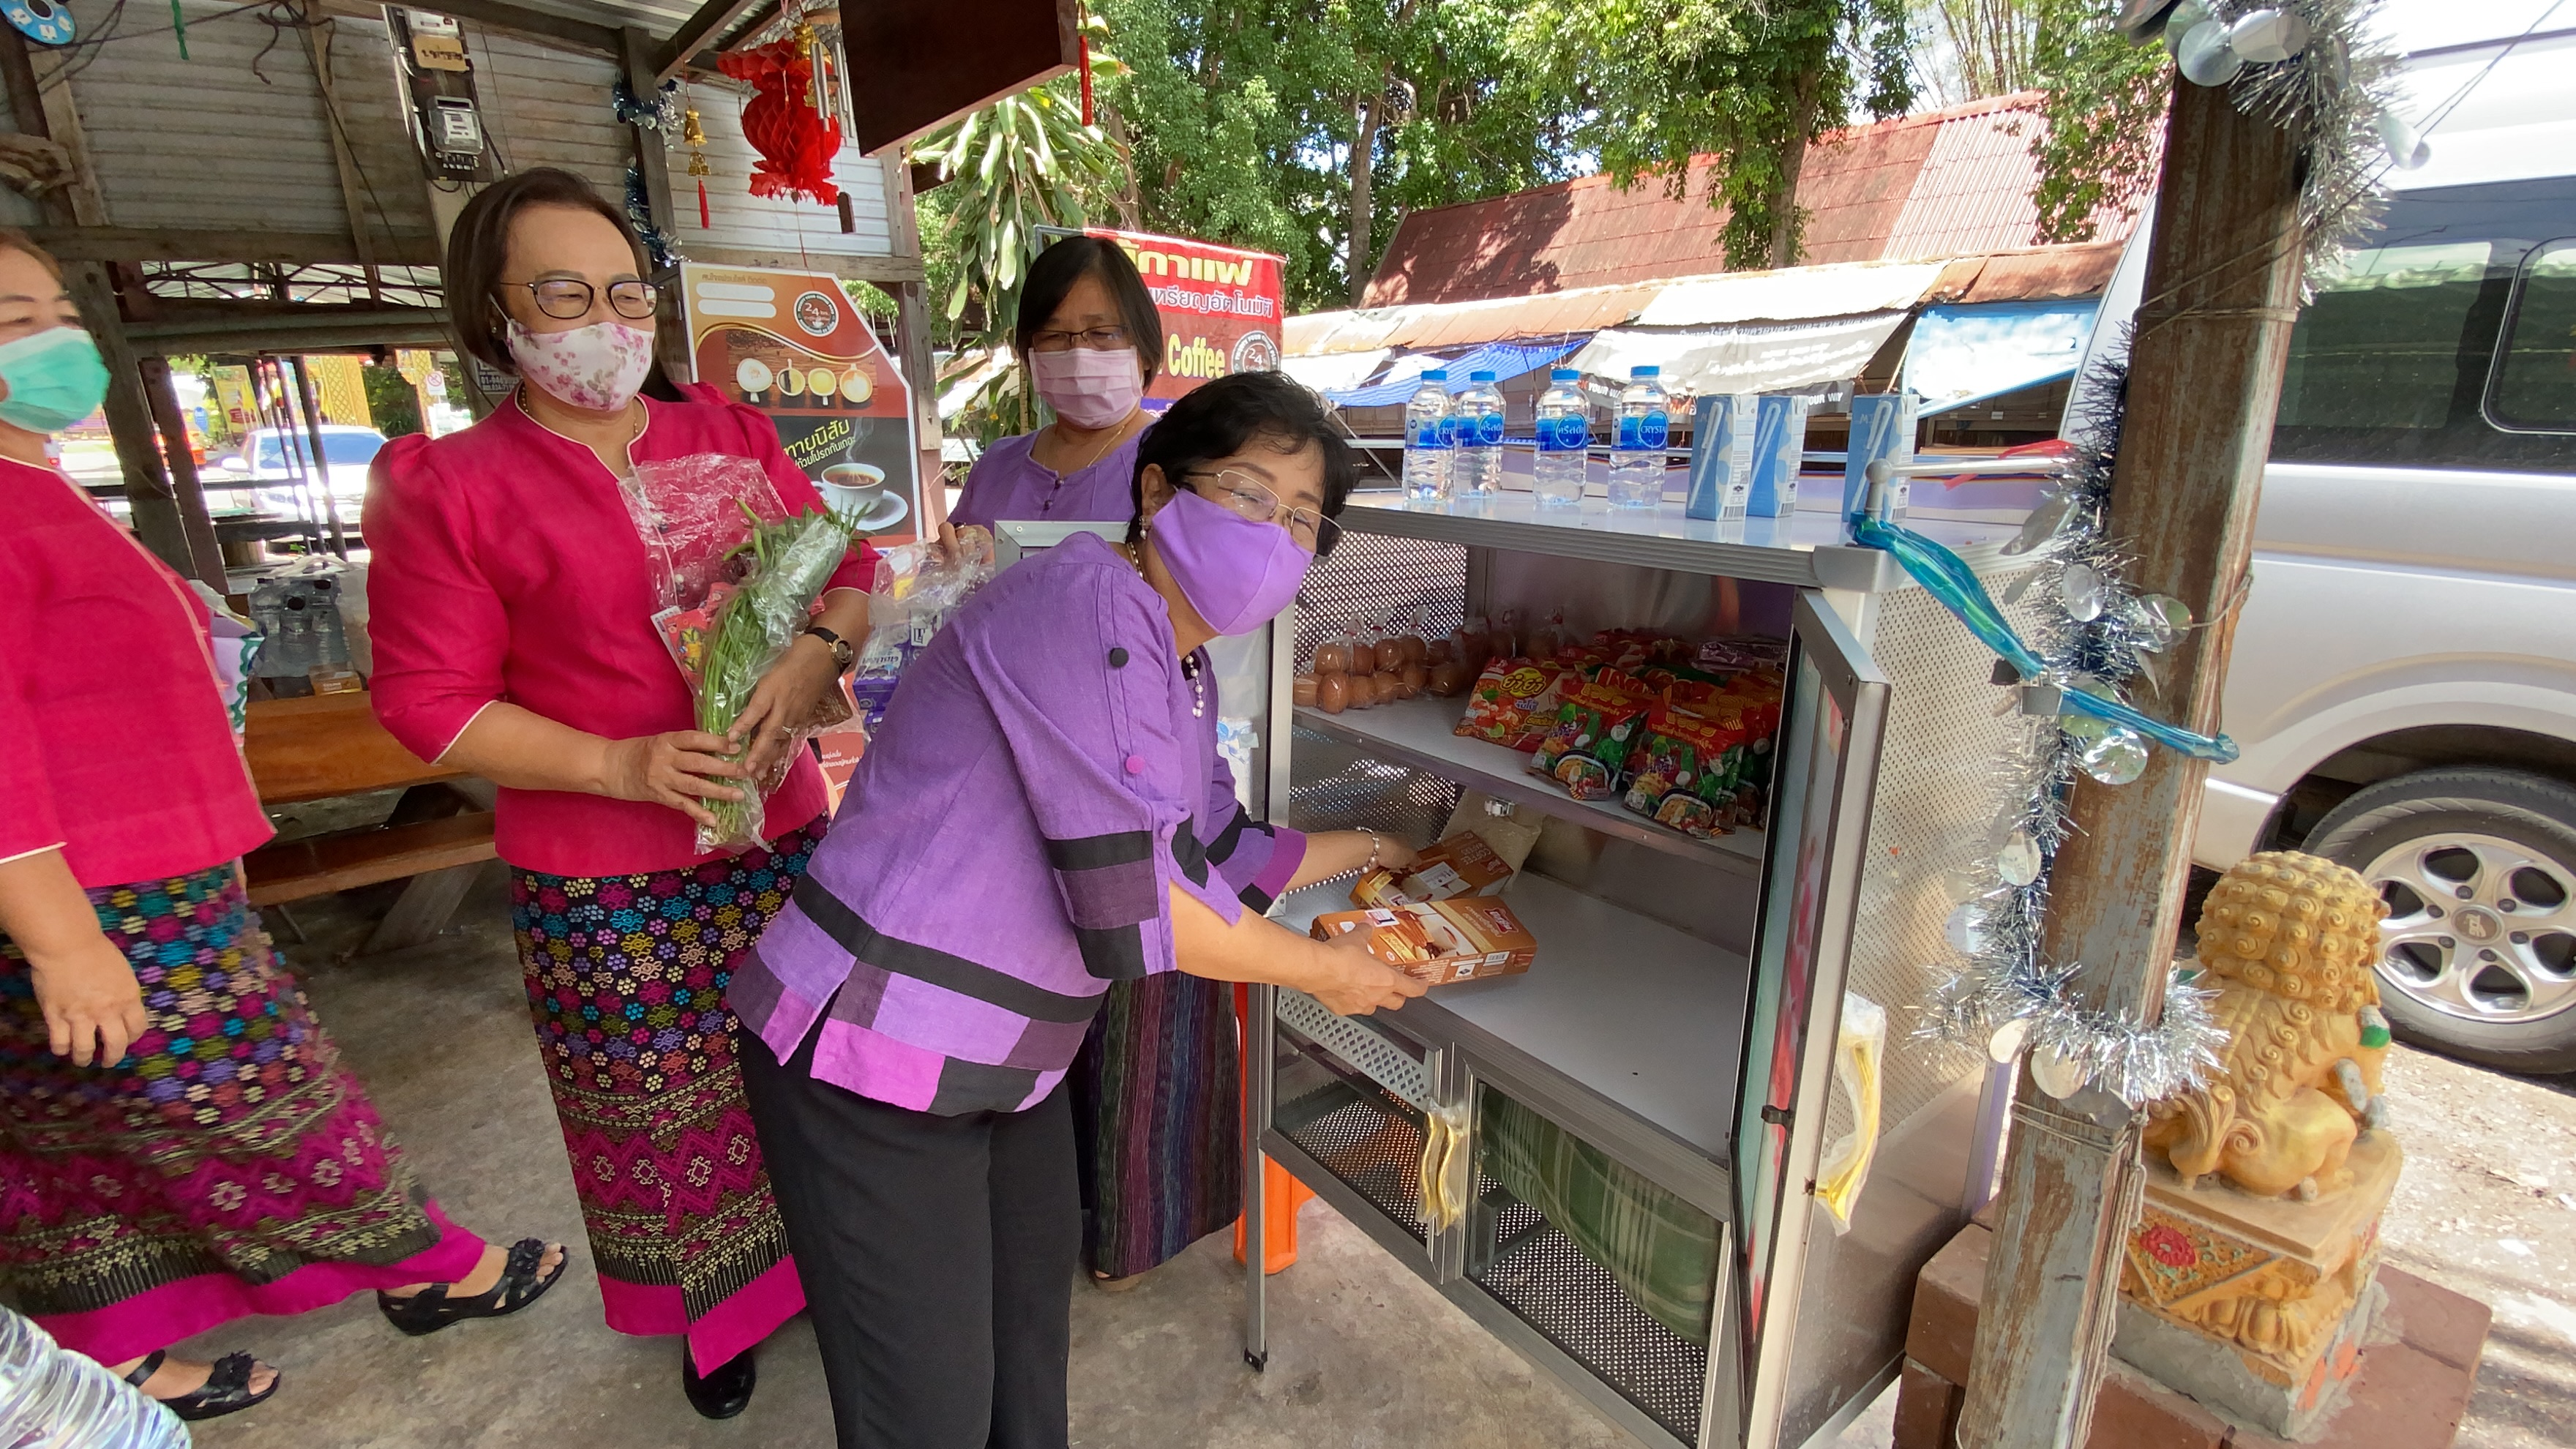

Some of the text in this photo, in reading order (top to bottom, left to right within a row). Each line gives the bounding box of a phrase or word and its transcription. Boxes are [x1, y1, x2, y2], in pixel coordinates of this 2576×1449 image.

[805, 302, 820, 316] 24
[1168, 333, 1226, 379] Coffee
[1247, 347, 1264, 366] 24
[1808, 394, 1825, 406] OUR
